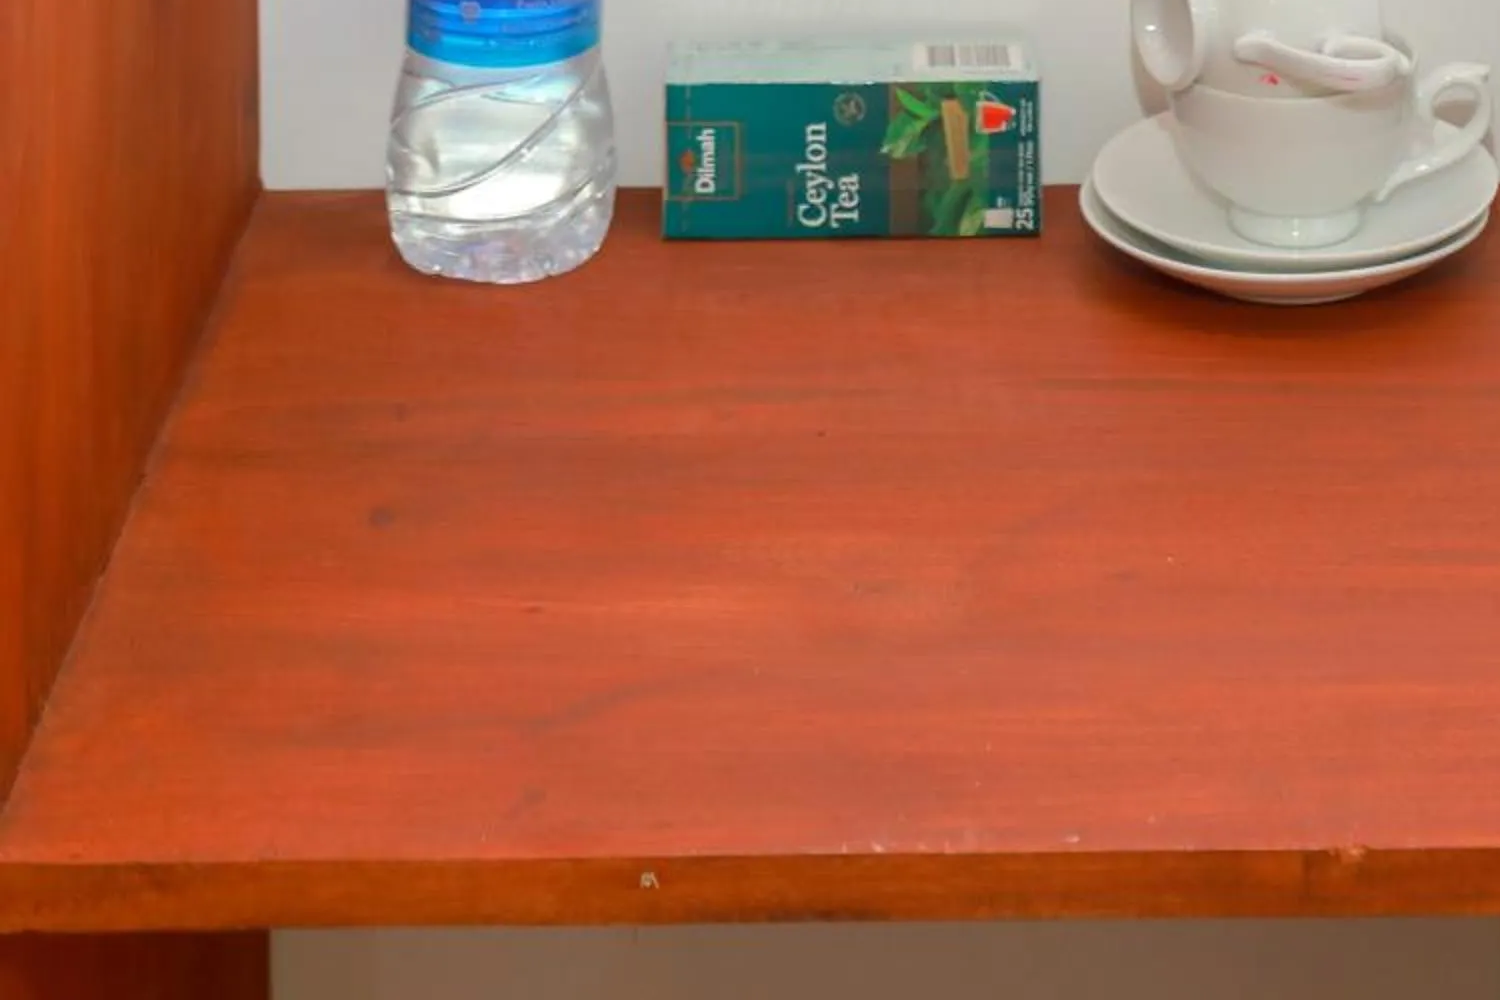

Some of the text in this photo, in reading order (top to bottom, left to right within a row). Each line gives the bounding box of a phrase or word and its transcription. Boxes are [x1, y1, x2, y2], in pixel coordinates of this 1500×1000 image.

[695, 128, 716, 193] Dilmah
[795, 122, 834, 228] Ceylon
[829, 173, 860, 229] Tea
[1016, 208, 1034, 230] 25
